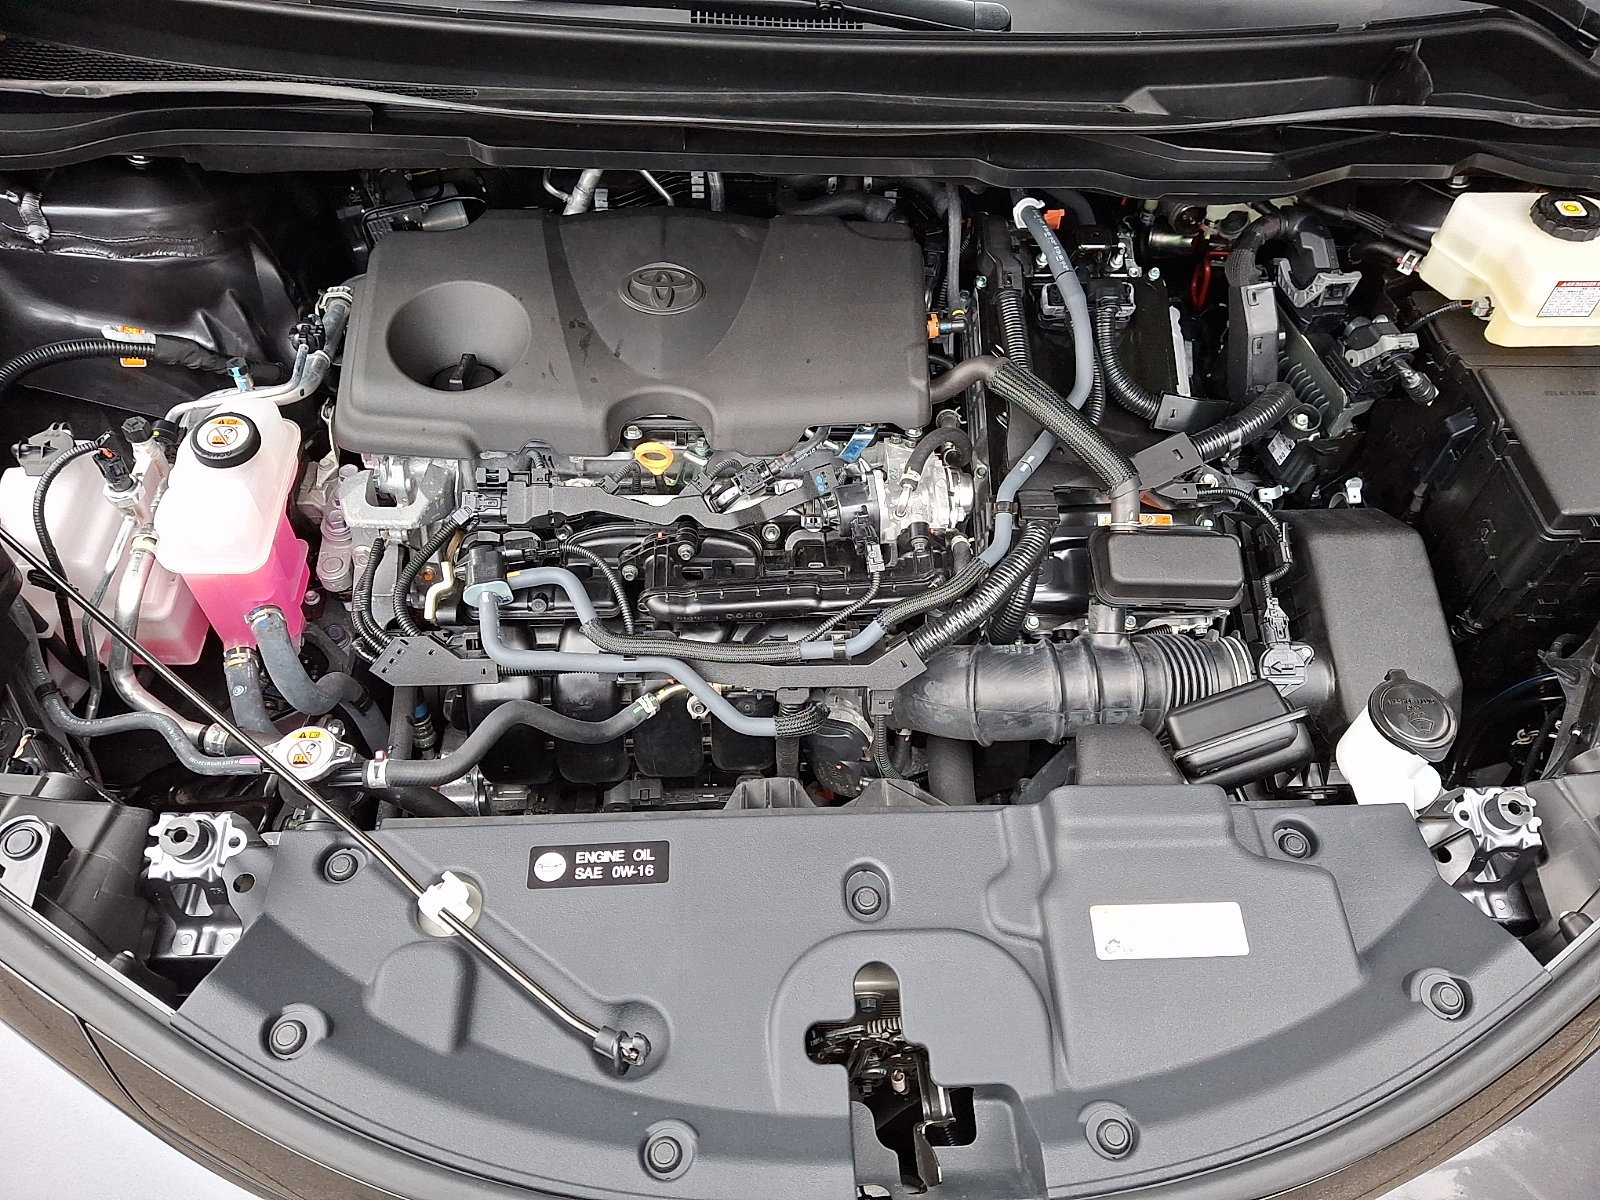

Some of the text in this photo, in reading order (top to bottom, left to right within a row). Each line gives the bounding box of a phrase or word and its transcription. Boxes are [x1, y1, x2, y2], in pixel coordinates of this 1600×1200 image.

[575, 848, 656, 864] ENGINE OIL
[574, 864, 655, 880] SAE 0W-16
